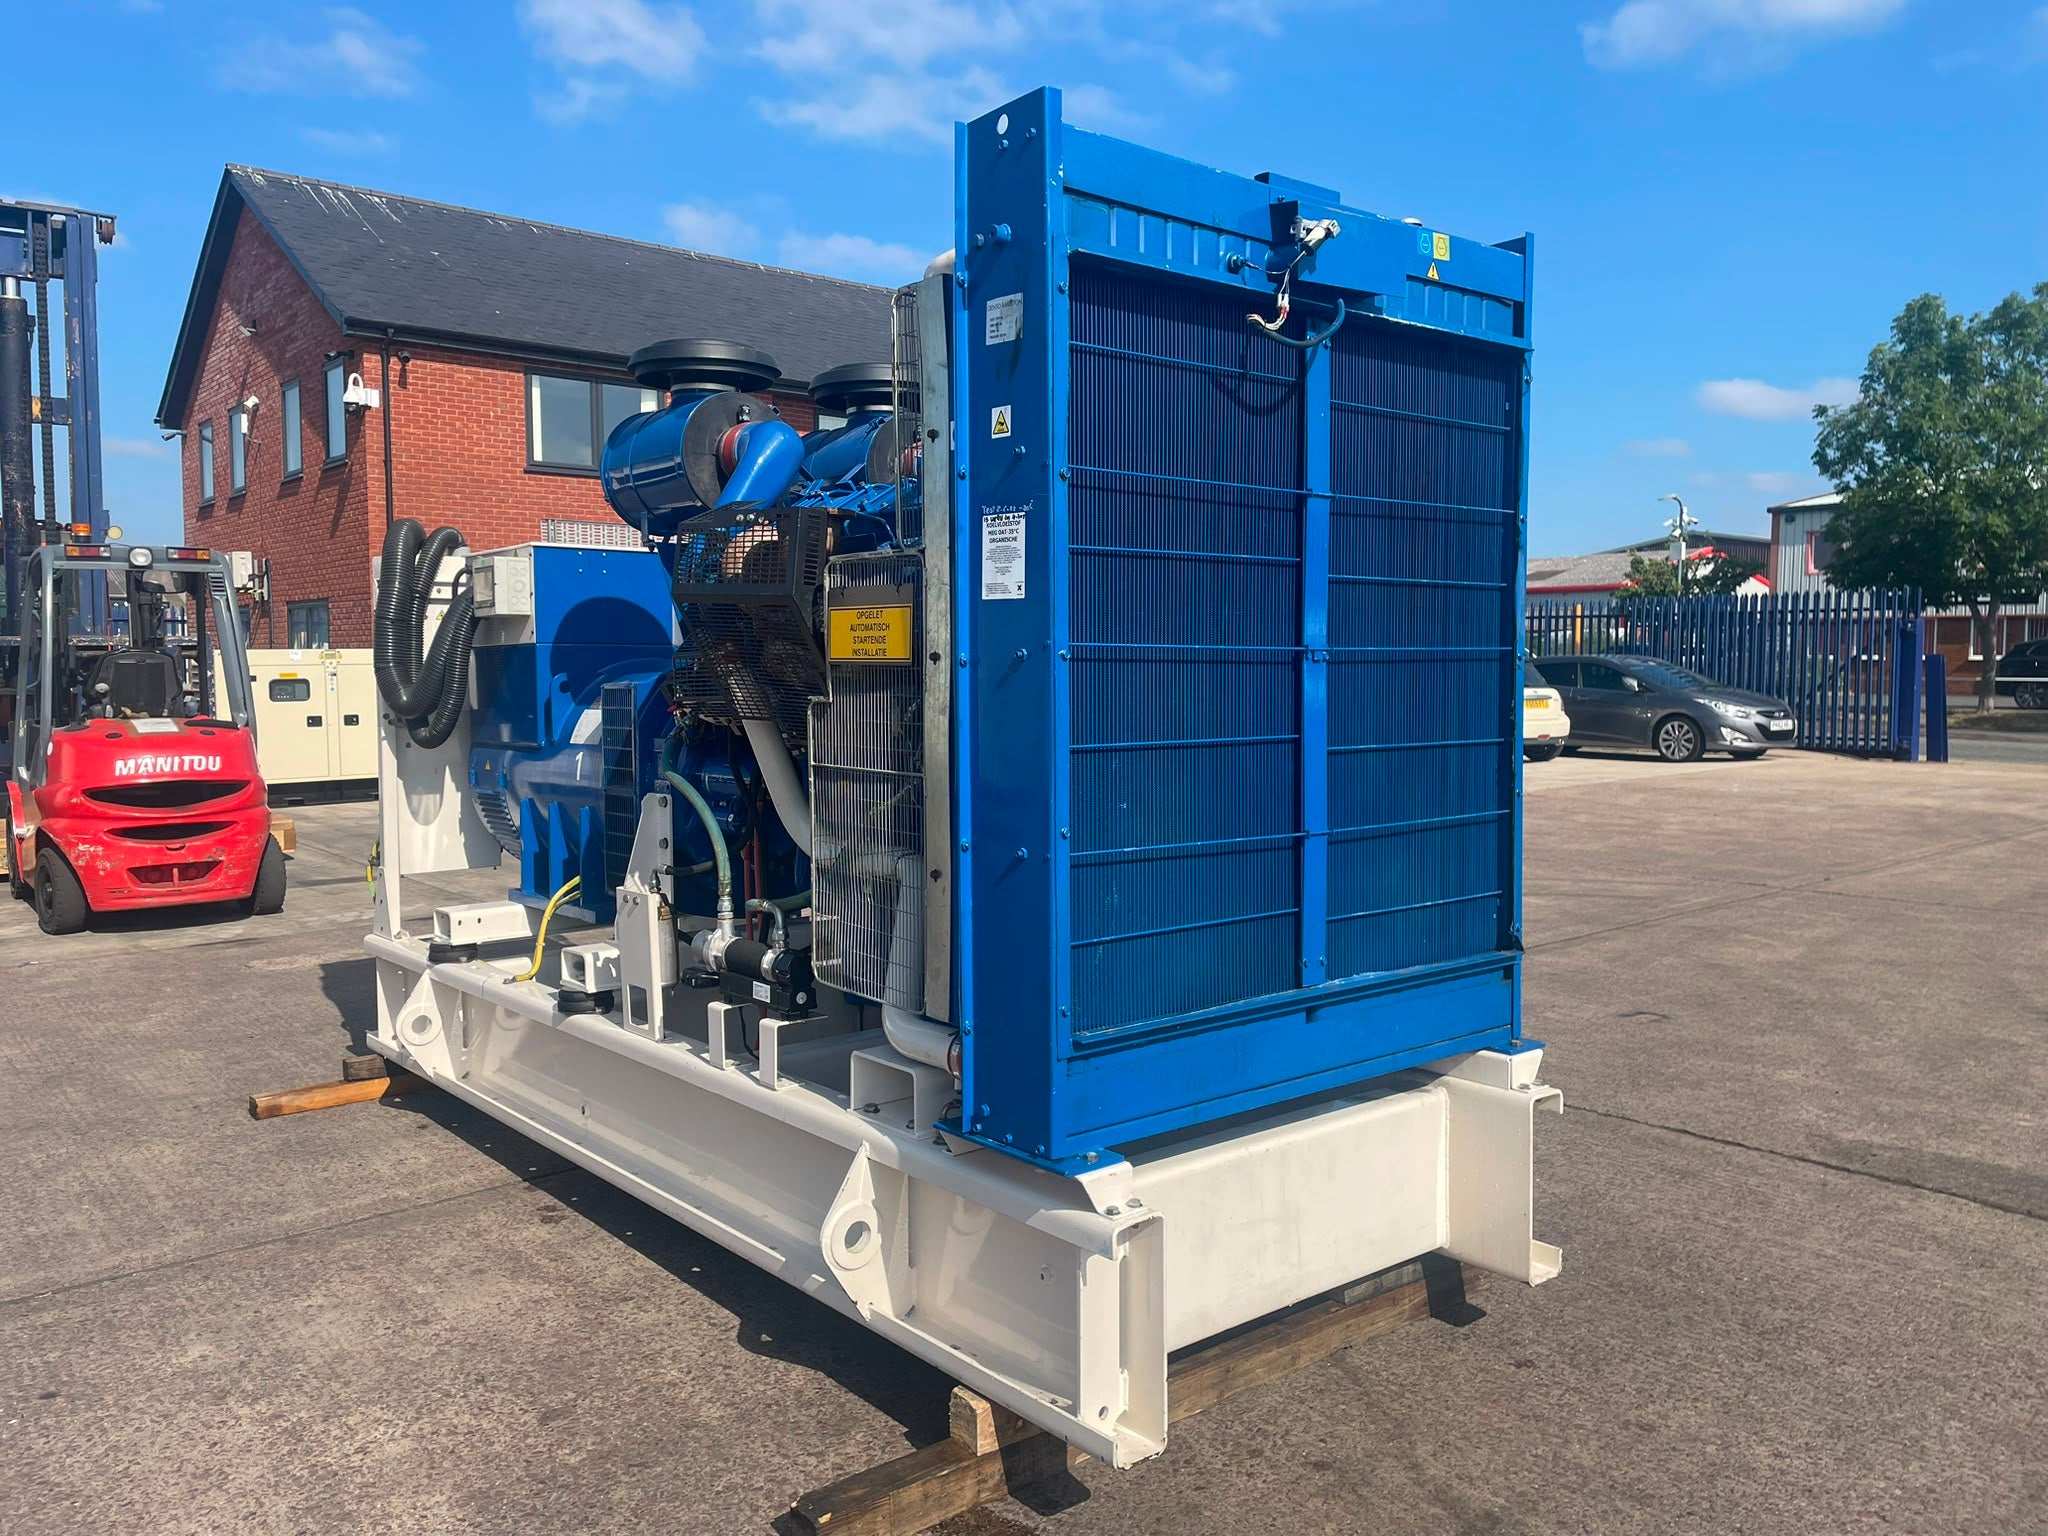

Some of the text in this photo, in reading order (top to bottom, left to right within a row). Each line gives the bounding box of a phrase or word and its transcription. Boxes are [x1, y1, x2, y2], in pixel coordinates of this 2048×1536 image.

[989, 536, 1018, 544] ORGANISCHE
[856, 610, 884, 620] OPGELET
[850, 623, 890, 632] AUTOMATISCH
[852, 635, 887, 645] STARTENDE
[852, 648, 887, 657] INSTALLATIE
[114, 755, 222, 777] MANITOU
[575, 751, 583, 781] 1
